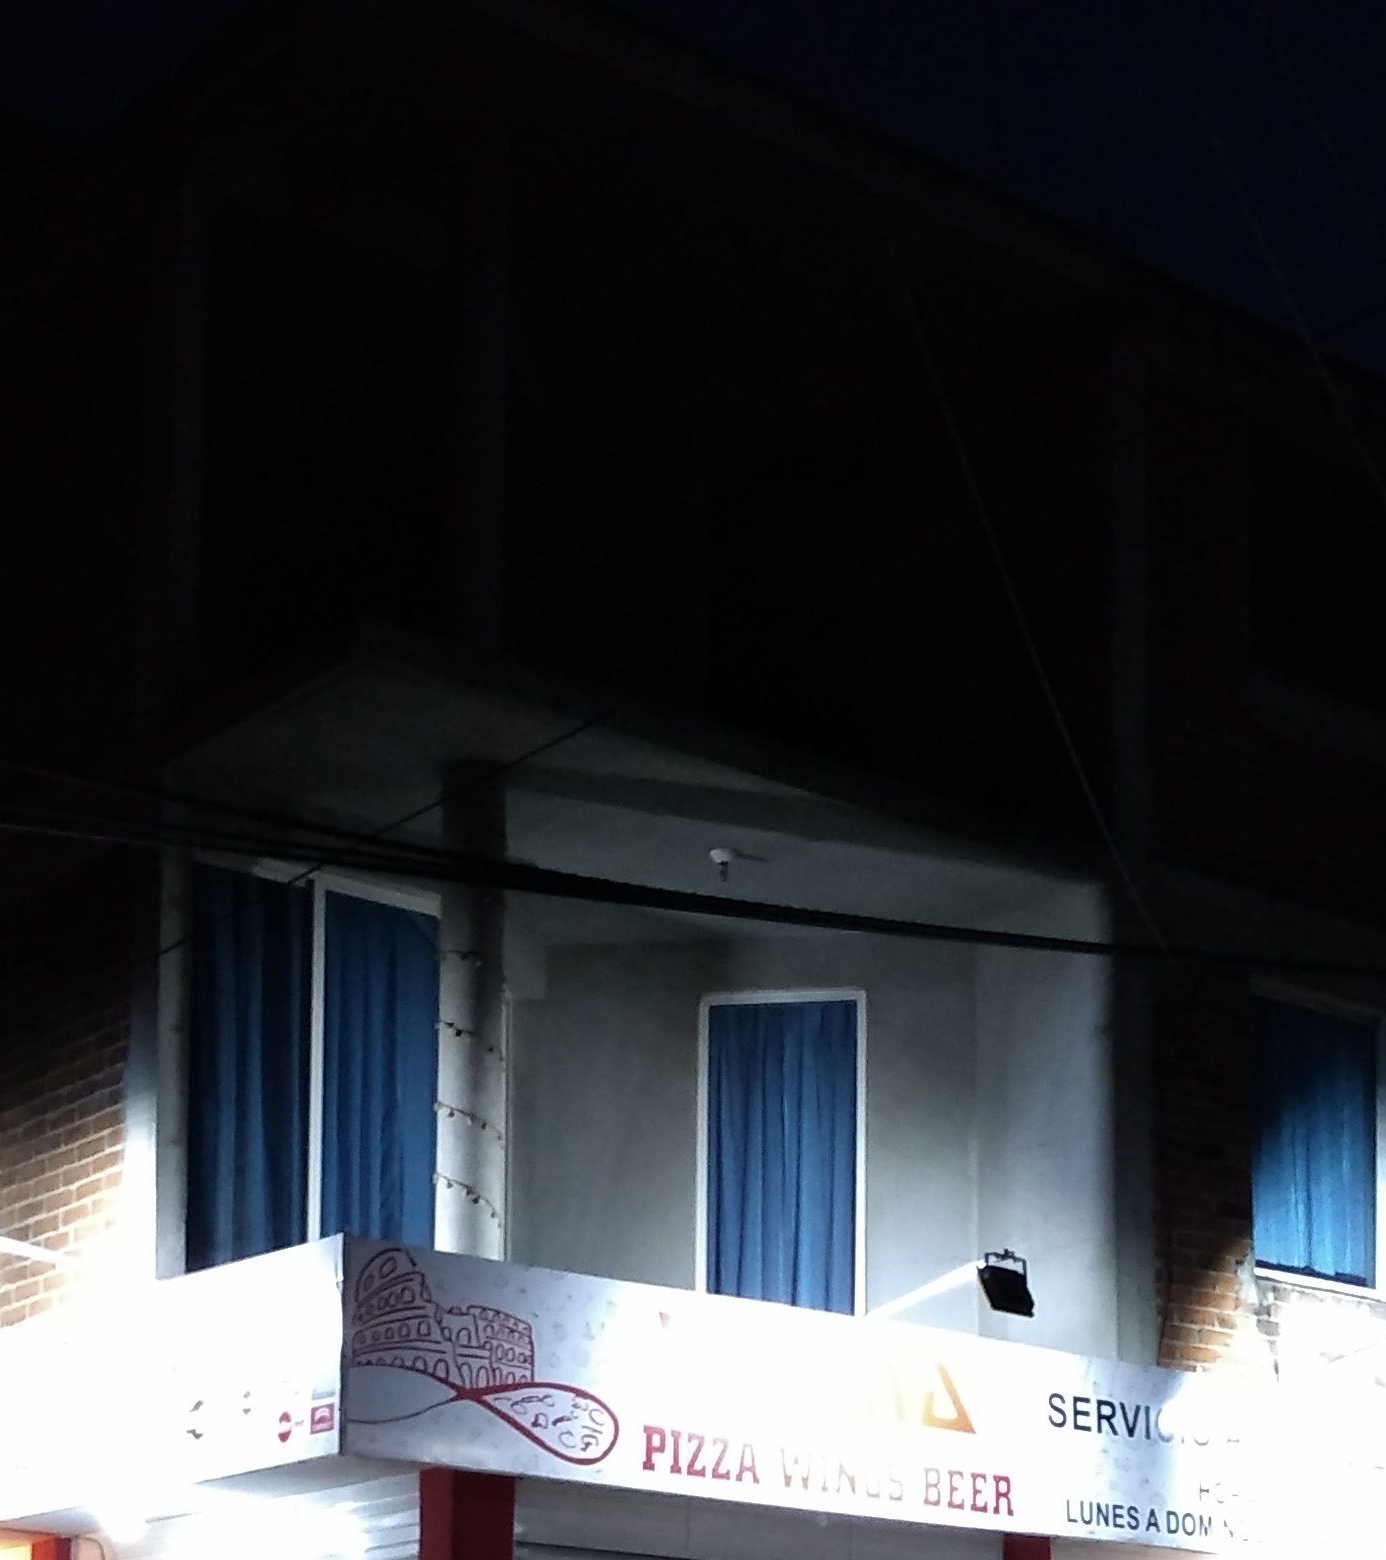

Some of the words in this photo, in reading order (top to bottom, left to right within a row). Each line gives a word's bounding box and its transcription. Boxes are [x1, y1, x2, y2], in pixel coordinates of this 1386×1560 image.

[641, 1423, 761, 1485] PIZZA
[922, 1466, 1015, 1517] BEER
[1066, 1498, 1140, 1532] LUNES
[1145, 1506, 1162, 1534] A
